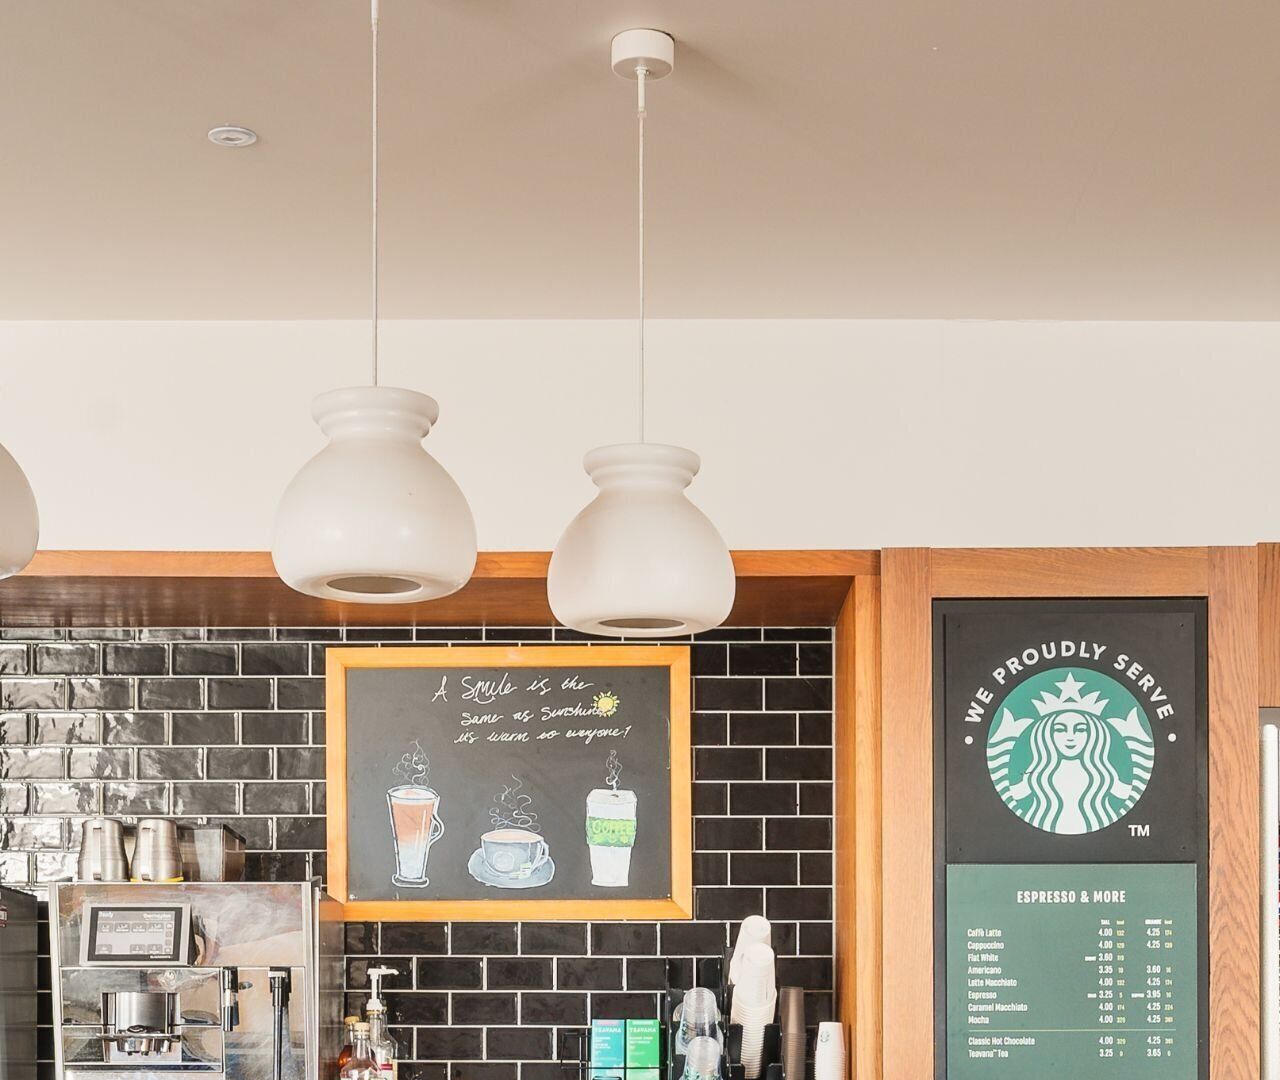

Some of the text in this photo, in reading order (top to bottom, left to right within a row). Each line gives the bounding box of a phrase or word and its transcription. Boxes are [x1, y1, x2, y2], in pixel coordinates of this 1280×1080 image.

[964, 640, 1174, 723] WE PROUDLY SERVE
[432, 676, 447, 702] A
[527, 676, 551, 695] is
[561, 675, 595, 690] the
[513, 710, 534, 722] as
[487, 731, 529, 742] warm
[1017, 891, 1126, 903] ESPRESSO & MORE
[1098, 928, 1112, 936] 4.00
[1147, 928, 1160, 936] 4.25
[968, 941, 1004, 950] Cappuccino
[1098, 941, 1112, 949] 4.00
[1147, 940, 1160, 948] 4.25
[968, 966, 1001, 974] Americano
[1099, 965, 1113, 973] 3.35
[1146, 965, 1160, 973] 3.60
[985, 978, 1017, 986] Macchiato
[1099, 978, 1113, 986] 4.00
[1147, 978, 1160, 986] 4.25
[968, 991, 997, 1000] Espresso
[1099, 990, 1112, 998] 3.25
[968, 1003, 994, 1011] Caramel
[995, 1003, 1028, 1011] Macchiato
[968, 1016, 989, 1024] Mocha
[1099, 1015, 1113, 1023] 4.00
[1147, 1015, 1161, 1023] 4.25
[968, 1037, 990, 1045] Classic
[992, 1037, 1003, 1045] Hot
[1004, 1036, 1035, 1045] Chocolate
[1099, 1036, 1113, 1044] 4.00
[1147, 1036, 1161, 1044] 4.25
[997, 1049, 1008, 1058] Tea
[1099, 1049, 1113, 1057] 3.25
